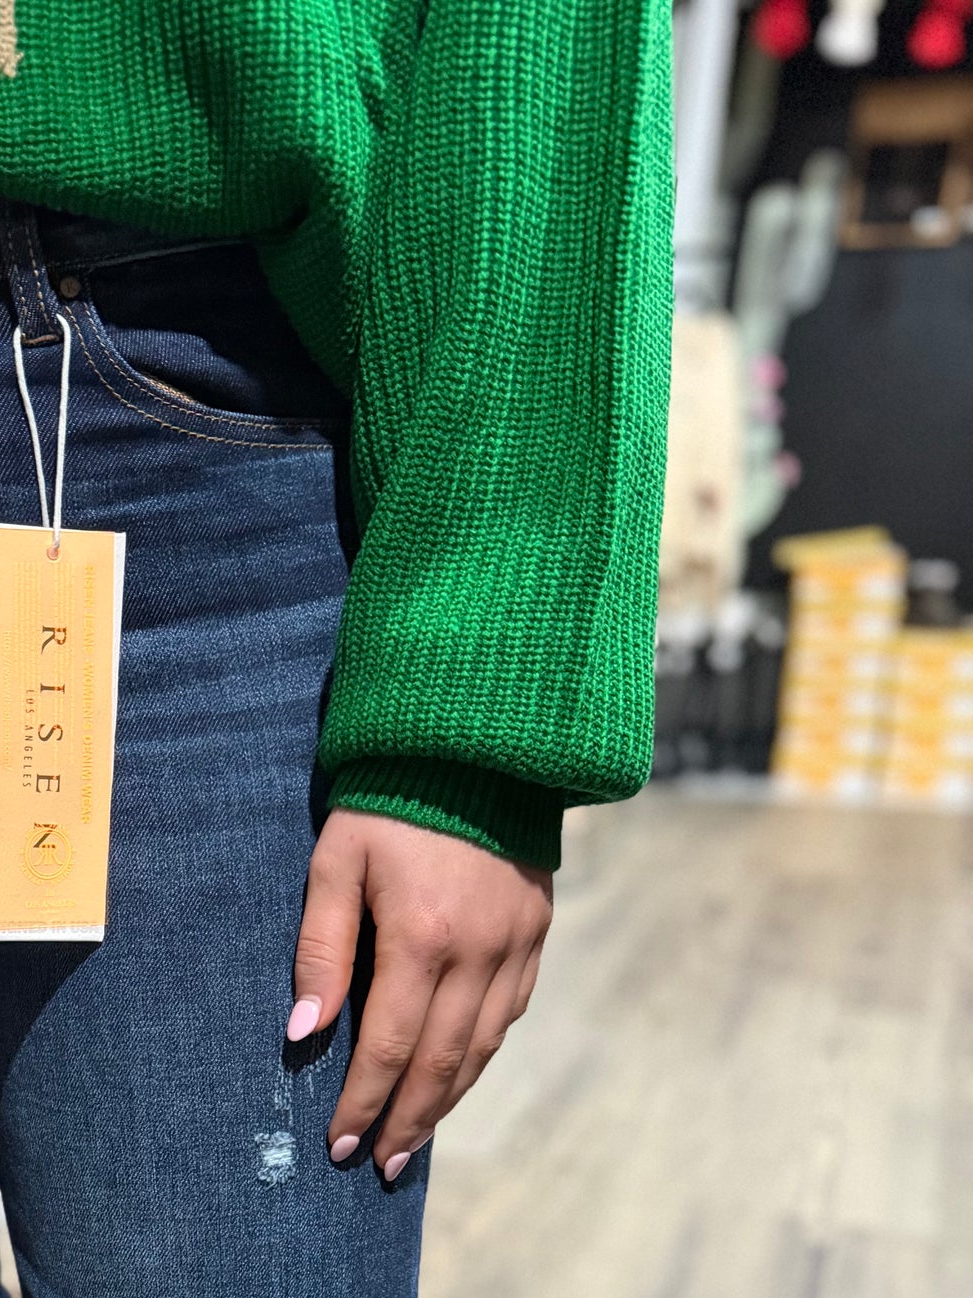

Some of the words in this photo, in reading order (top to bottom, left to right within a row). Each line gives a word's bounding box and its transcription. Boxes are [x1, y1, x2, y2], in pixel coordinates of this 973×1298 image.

[25, 689, 35, 714] LOS
[22, 724, 34, 788] ANGELES
[33, 625, 67, 849] RISEN
